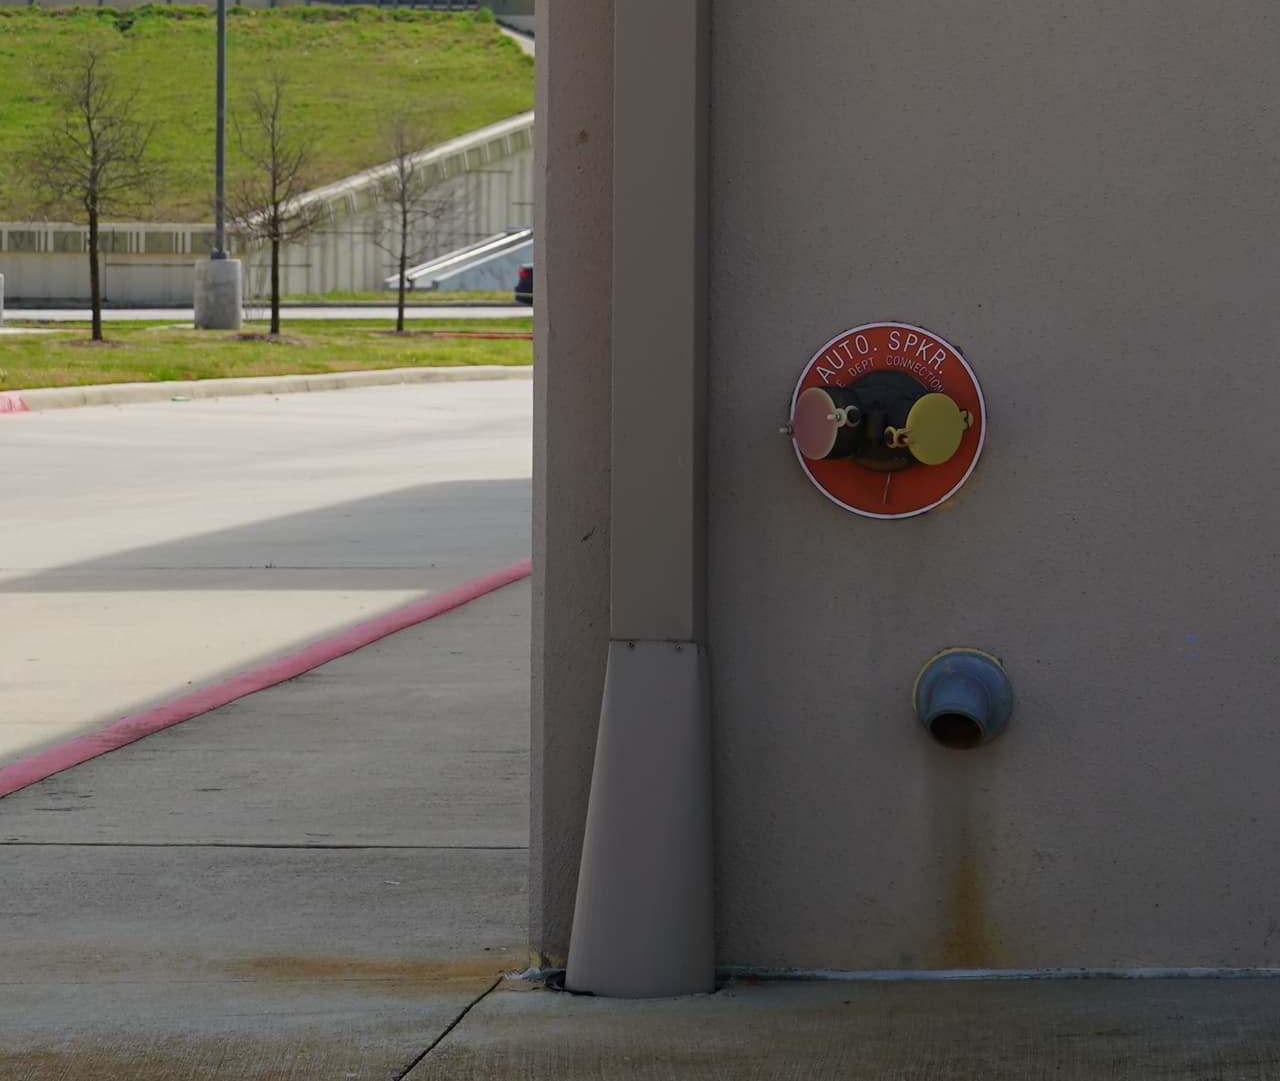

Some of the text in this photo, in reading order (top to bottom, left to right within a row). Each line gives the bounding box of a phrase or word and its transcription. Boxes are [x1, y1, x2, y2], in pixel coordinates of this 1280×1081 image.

[816, 330, 947, 384] AUTO. SPKR.
[848, 357, 875, 377] DEPT
